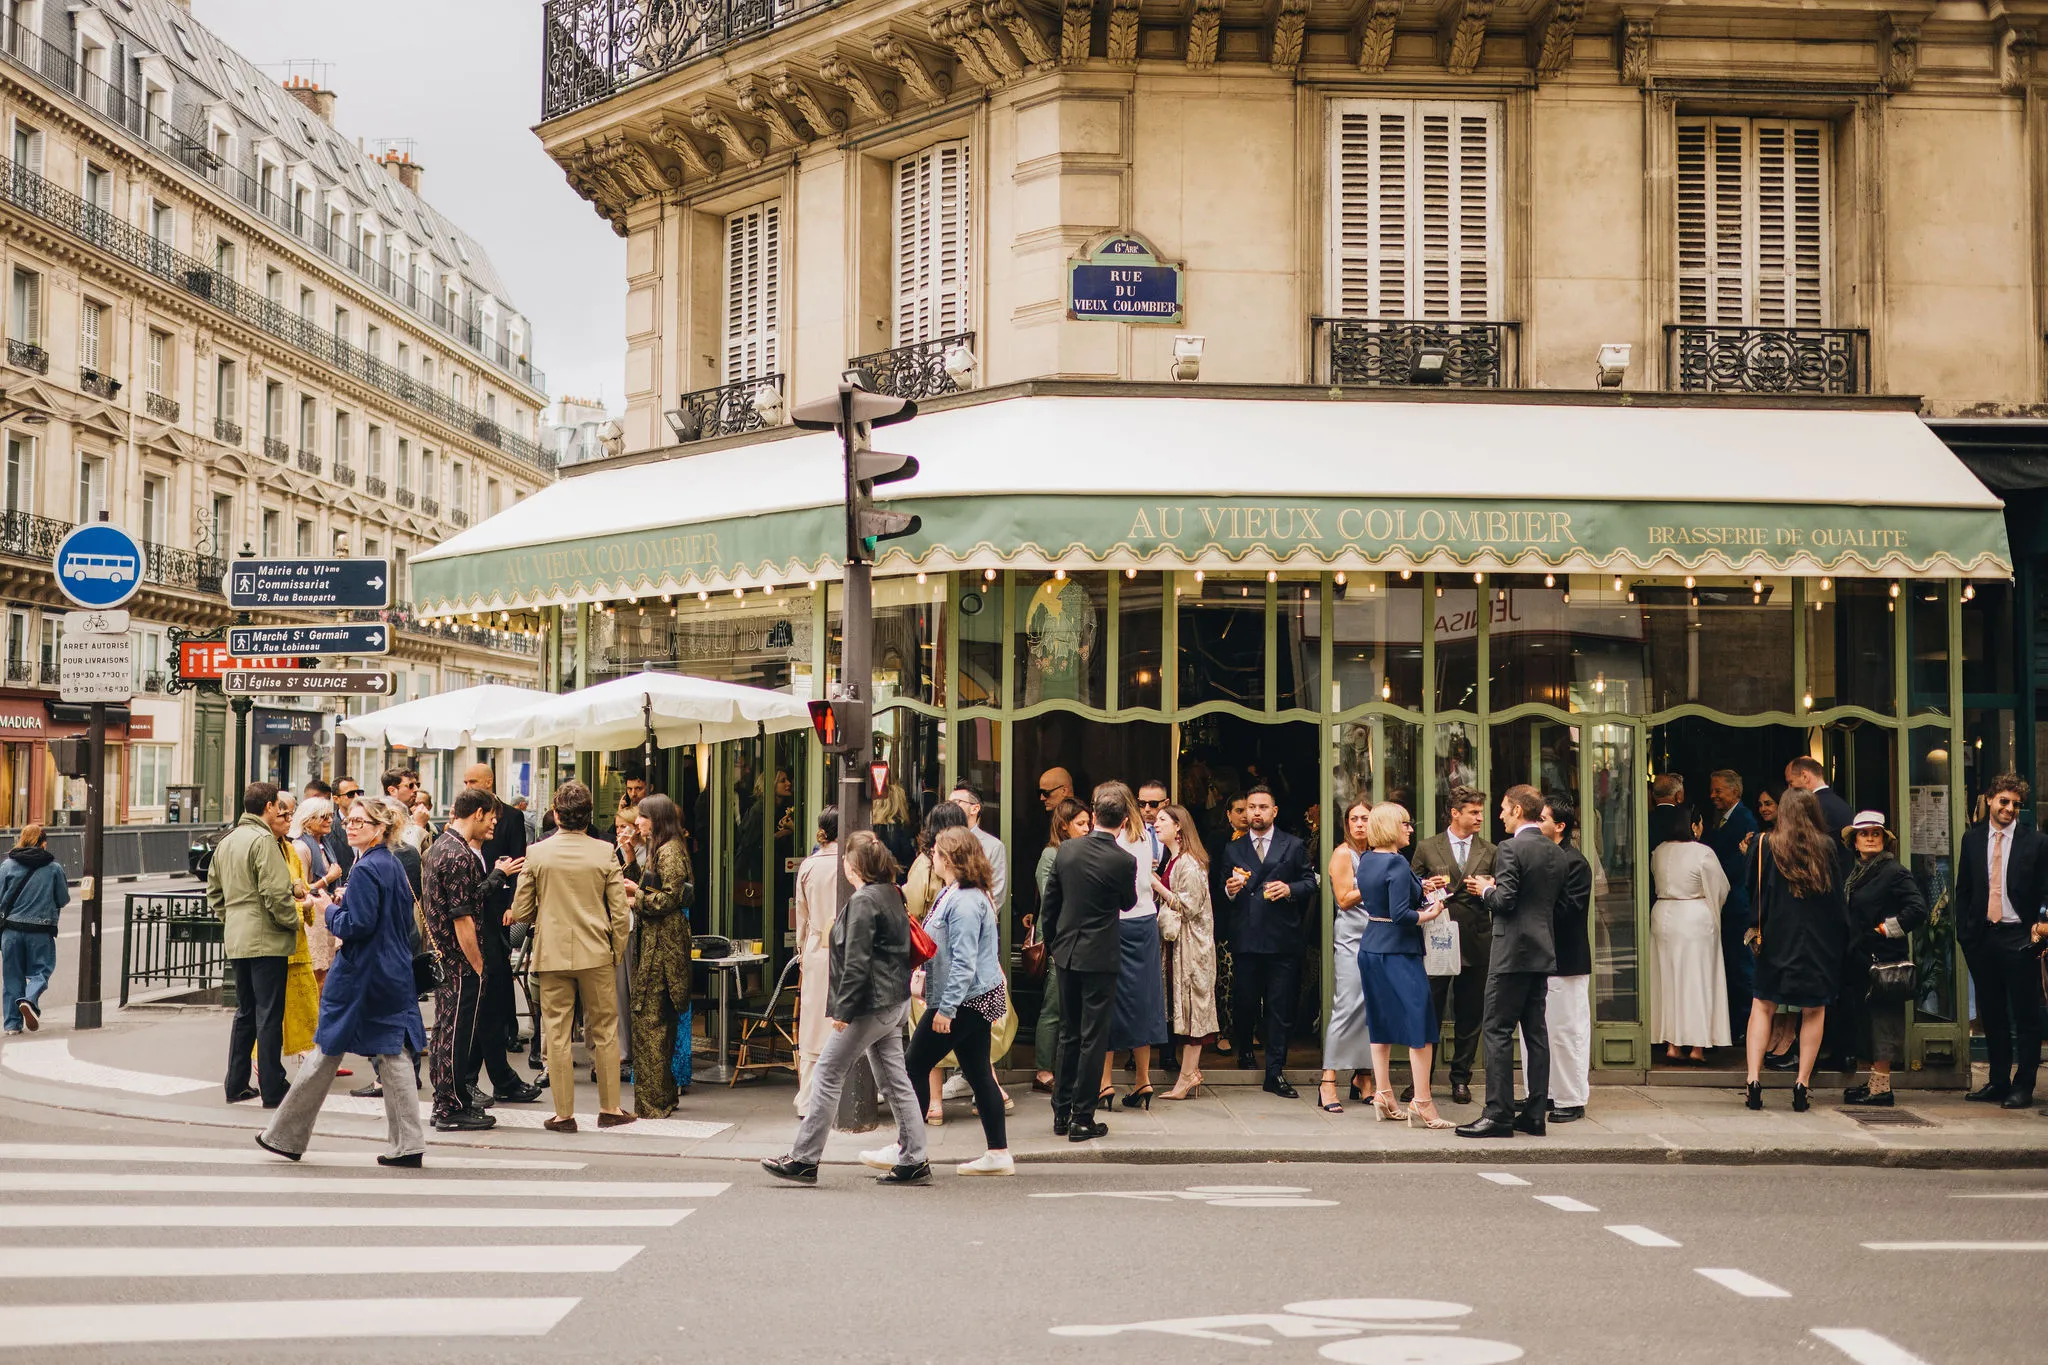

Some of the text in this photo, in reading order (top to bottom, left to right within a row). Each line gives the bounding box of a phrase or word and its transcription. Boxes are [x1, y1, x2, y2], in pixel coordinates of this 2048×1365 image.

[1110, 270, 1142, 282] RUE
[1115, 285, 1136, 296] DU
[1074, 299, 1176, 313] VIEUX COLOMBIER
[1127, 506, 1578, 543] AU VIEUX COLOMBIER
[1647, 525, 1909, 548] BRASSERIE DE QUALITE
[505, 532, 722, 584] AU VIEUX COLOMBIER
[257, 565, 292, 576] Mairie
[296, 565, 309, 575] du
[257, 580, 330, 590] Commissariat
[273, 593, 289, 602] Rue
[292, 593, 336, 604] Bonaparte
[252, 629, 350, 641] Marché St Germain
[63, 641, 129, 650] ARRET AUTORISÉ
[264, 643, 279, 652] Rue
[282, 643, 320, 652] Lobineau
[85, 656, 129, 664] LIVRAISONS
[249, 674, 282, 689] Église
[303, 677, 348, 688] SULPICE
[0, 715, 42, 729] MADURA
